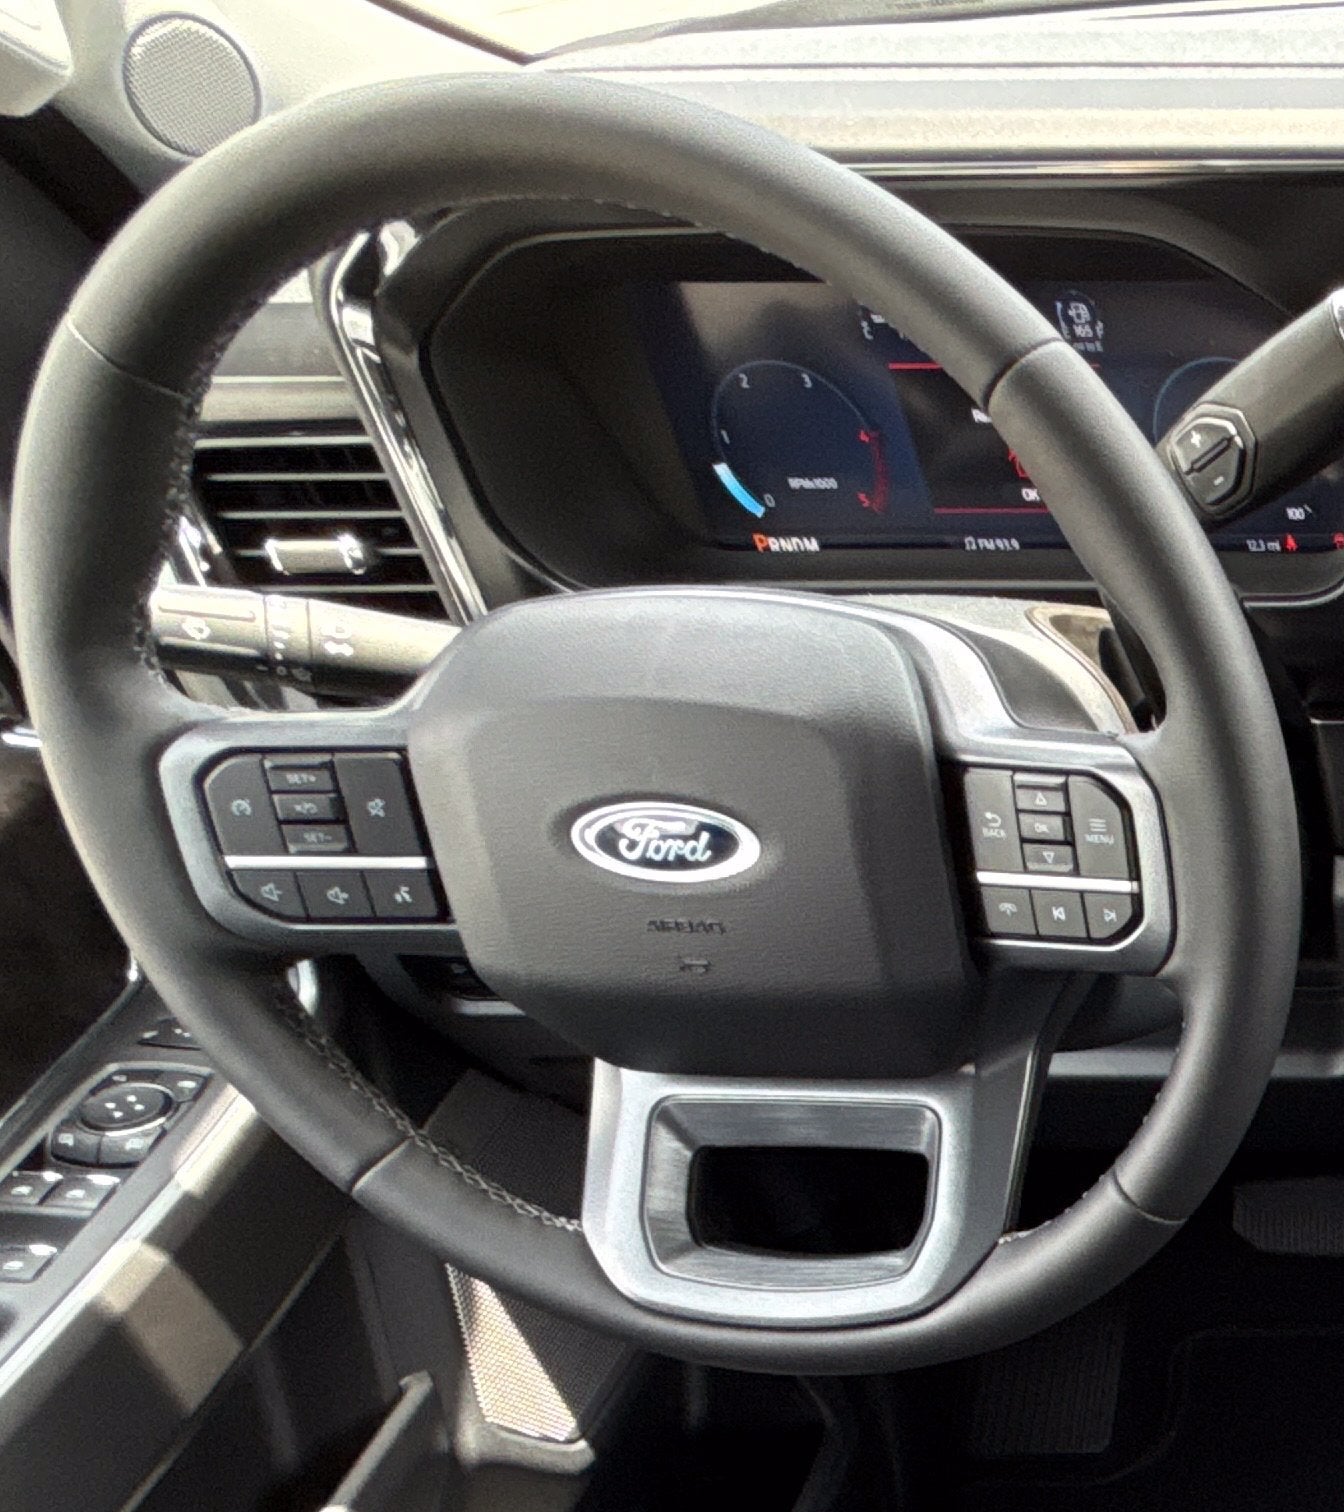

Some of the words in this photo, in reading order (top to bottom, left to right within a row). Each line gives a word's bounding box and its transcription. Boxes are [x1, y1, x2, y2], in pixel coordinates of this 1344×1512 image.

[738, 373, 750, 389] 2
[801, 373, 813, 389] 3
[763, 493, 776, 508] 0
[618, 817, 712, 862] Ford
